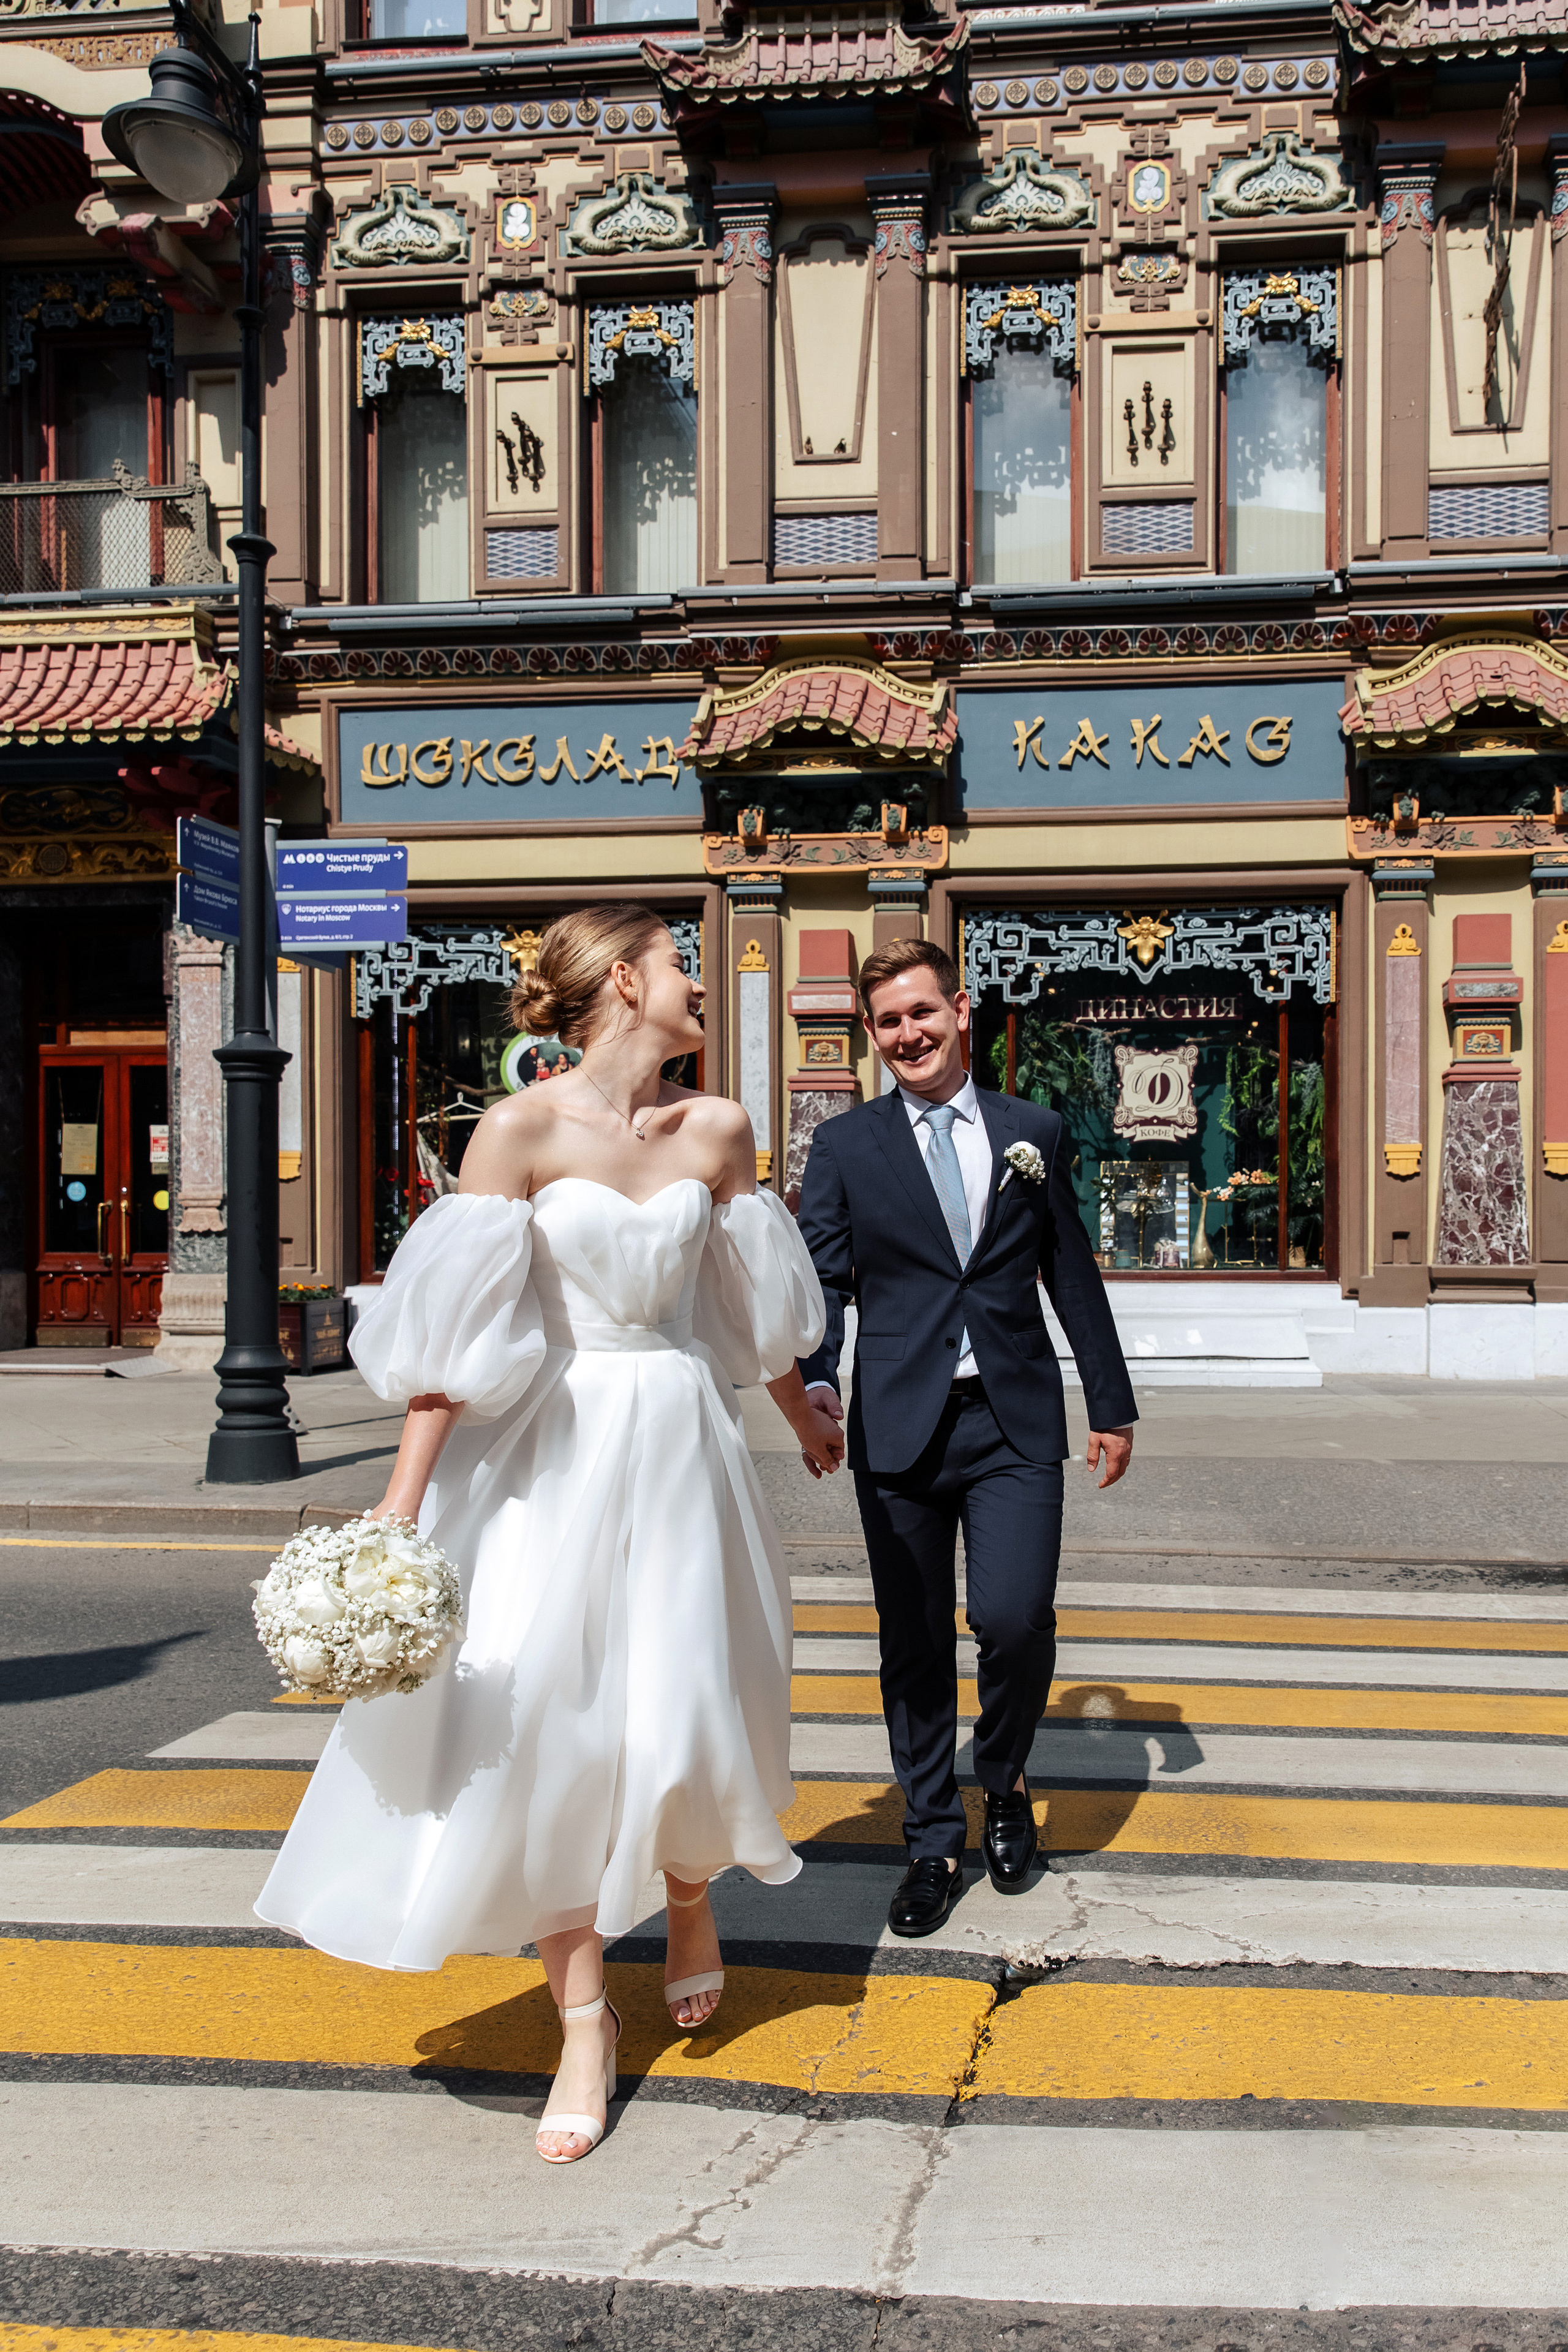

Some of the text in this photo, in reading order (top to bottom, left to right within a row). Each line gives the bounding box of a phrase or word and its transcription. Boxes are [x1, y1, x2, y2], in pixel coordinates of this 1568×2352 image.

[1012, 714, 1292, 767] КАКАО
[360, 733, 679, 786] ШОКОЛАД
[194, 830, 210, 842] Музей
[326, 853, 360, 862] Чистые
[361, 853, 391, 864] пруды
[326, 864, 374, 873] Chistye Prudy
[194, 884, 238, 905] Дом Якова Брюса
[295, 903, 387, 914] Нотариус города Москвы
[295, 914, 318, 923] Notary
[1075, 997, 1237, 1023] ДИНАСТИЯ
[1140, 1128, 1171, 1138] КОФЕ
